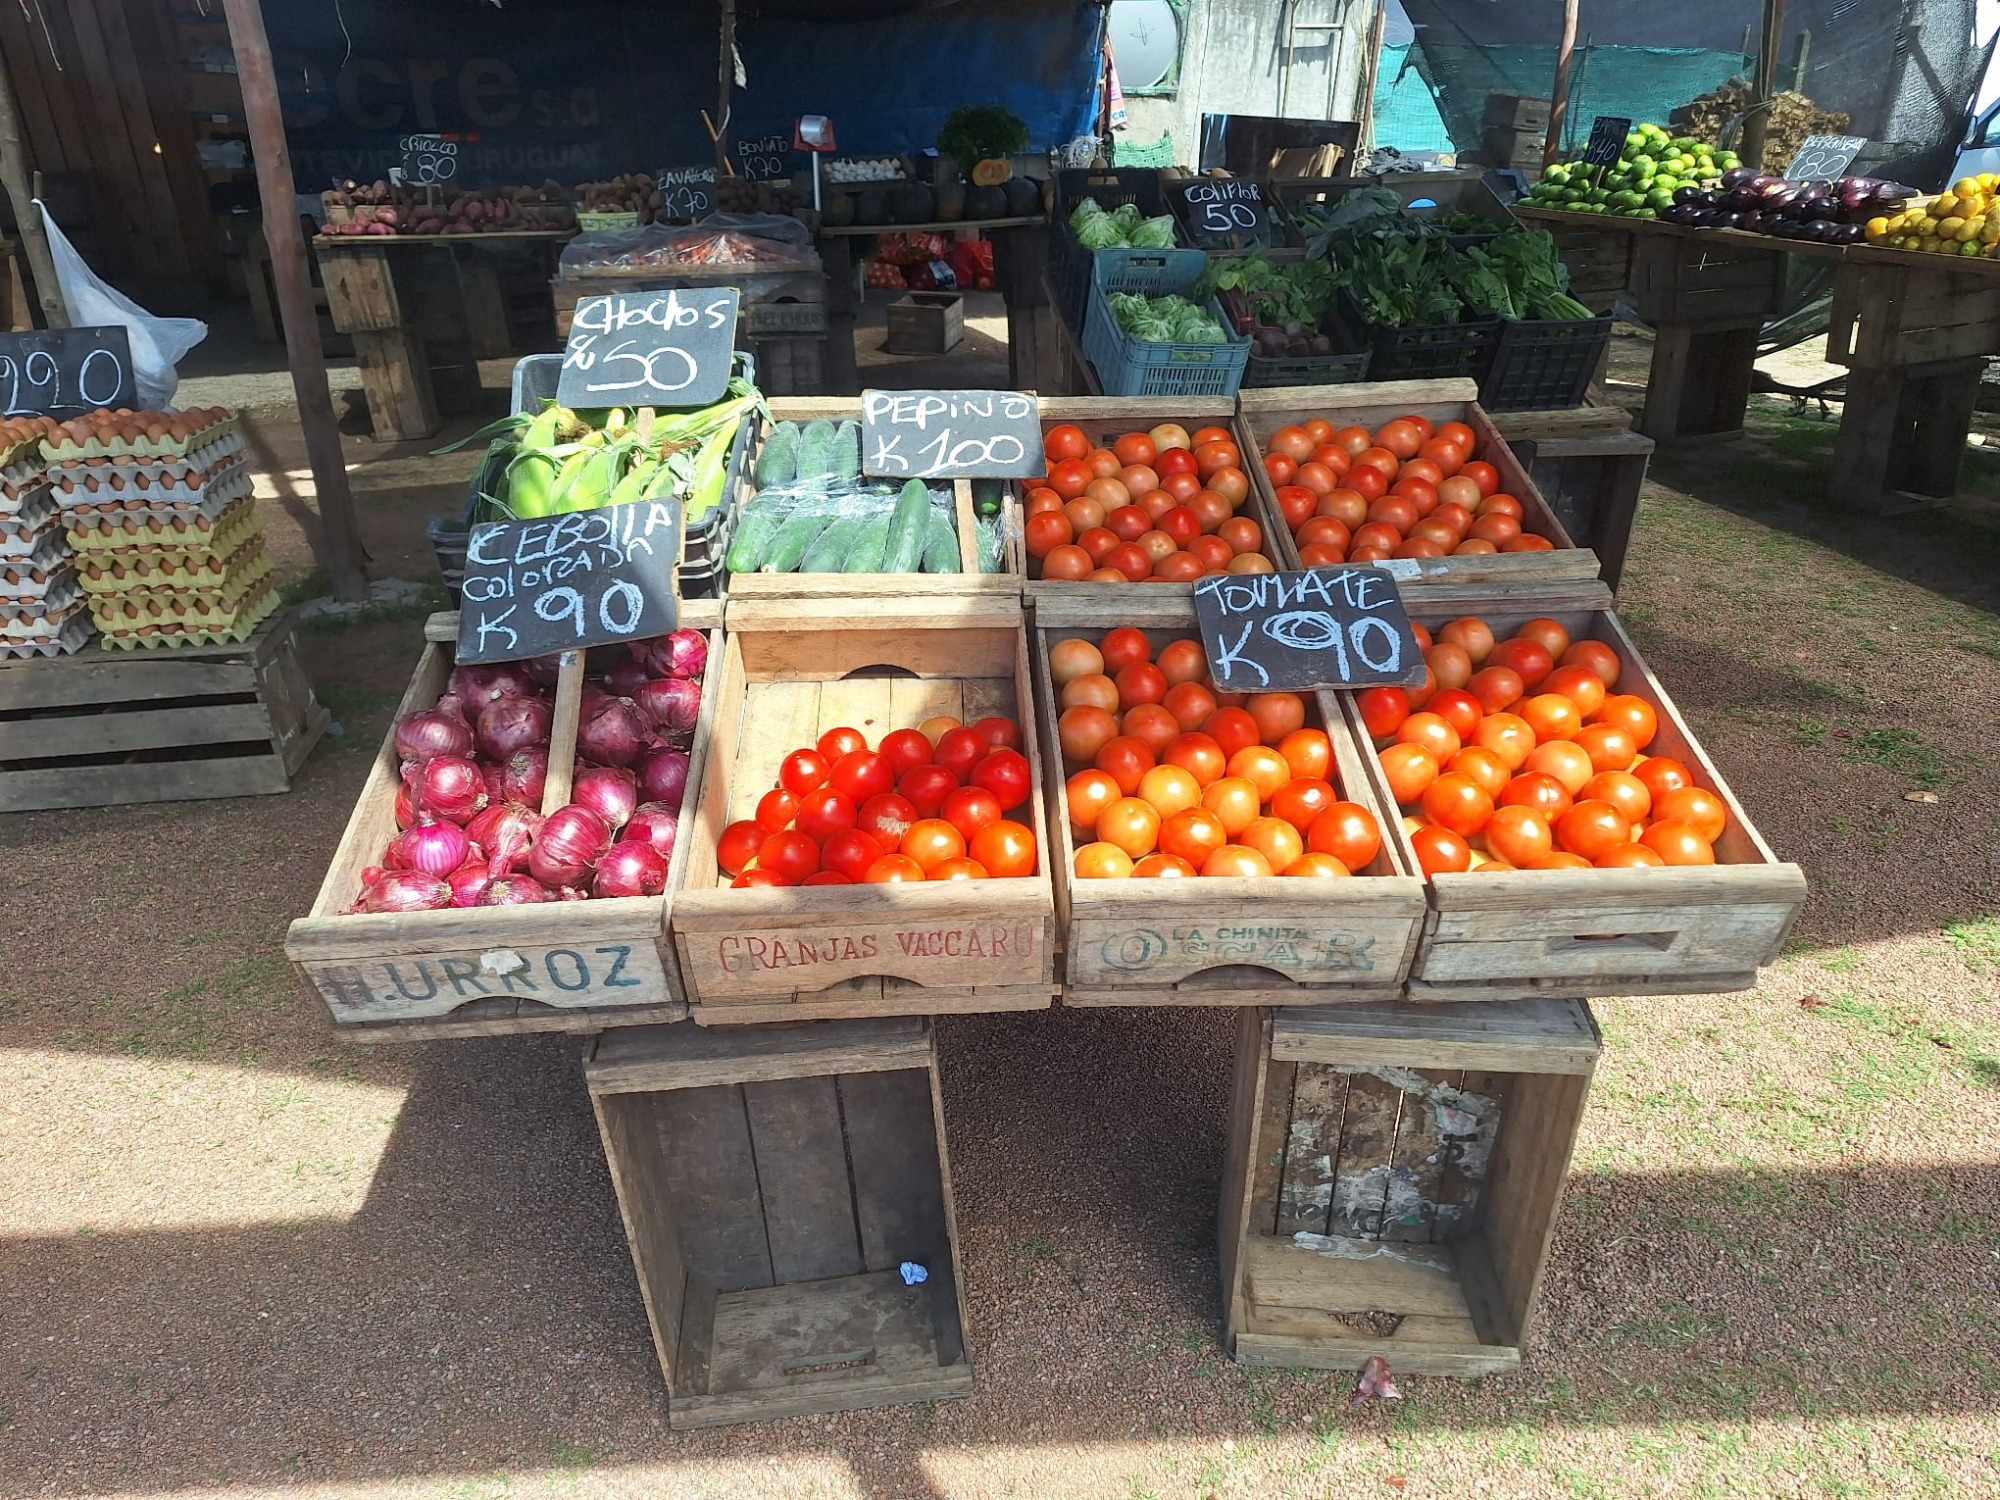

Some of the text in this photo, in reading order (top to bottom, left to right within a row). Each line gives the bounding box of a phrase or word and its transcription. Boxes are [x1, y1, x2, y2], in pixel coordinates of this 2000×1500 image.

[399, 135, 458, 155] CRIOLLO
[1797, 151, 1847, 179] 80
[417, 153, 456, 183] 80
[1203, 203, 1257, 231] 50
[586, 340, 698, 392] 50
[870, 428, 1025, 477] K 100
[1195, 570, 1394, 615] TOMATE
[477, 578, 644, 653] K 90
[1216, 610, 1400, 686] K 90
[719, 919, 1034, 973] GRANJAS VACCARO
[1172, 927, 1310, 941] LA CHINITA
